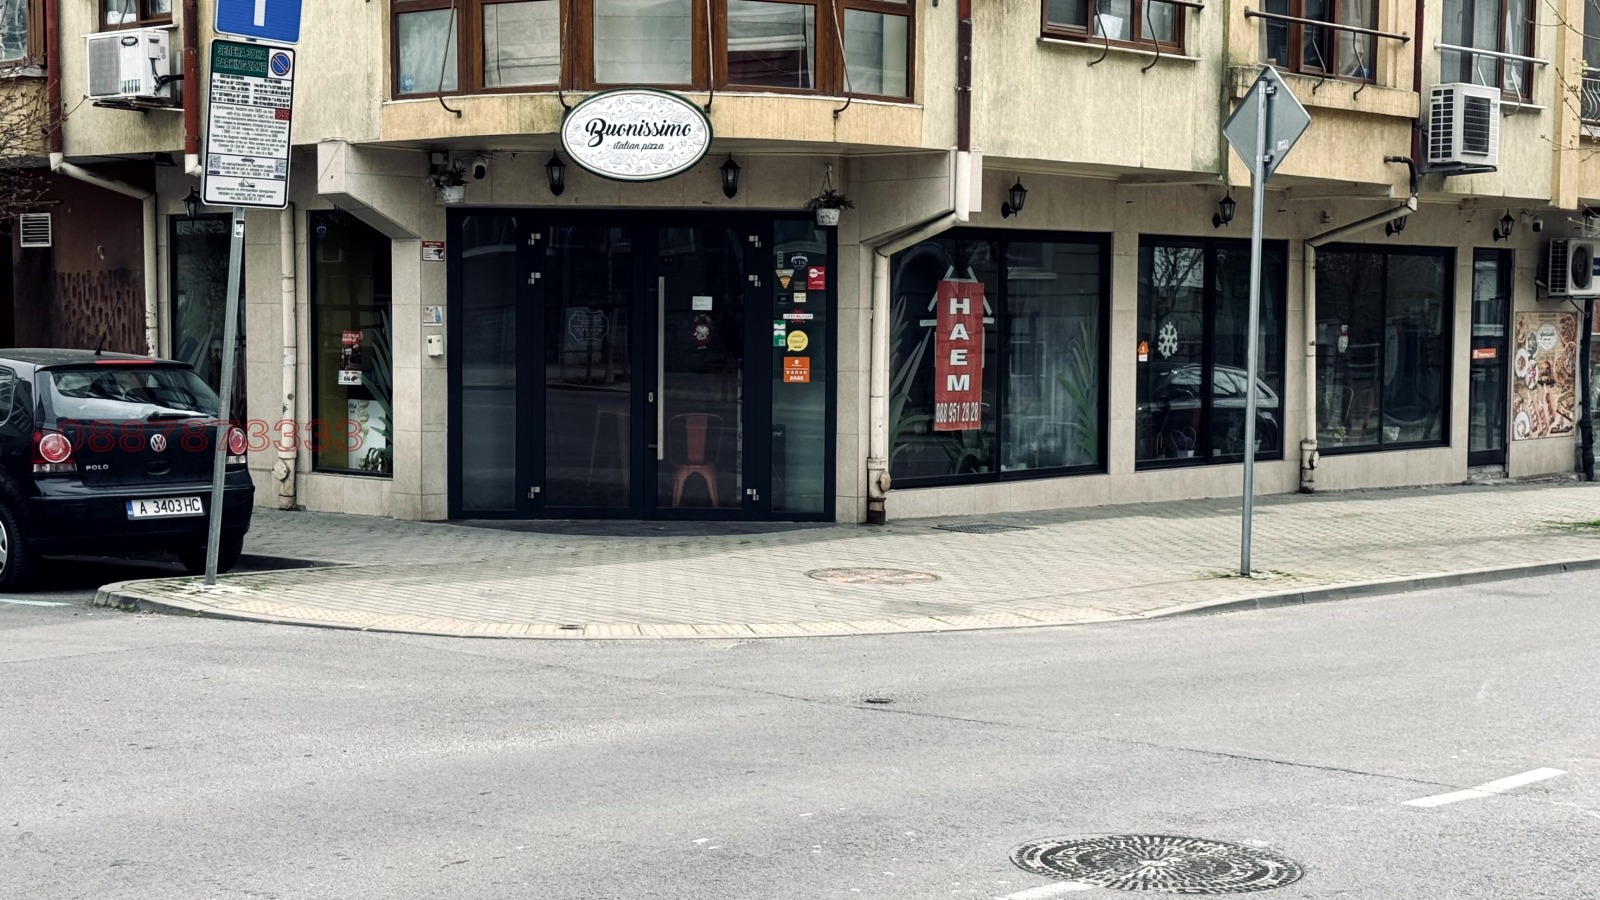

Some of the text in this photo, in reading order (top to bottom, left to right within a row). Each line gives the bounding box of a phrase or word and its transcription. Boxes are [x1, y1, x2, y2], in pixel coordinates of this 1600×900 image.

[217, 45, 266, 60] ЗЕЛЕНА ЗОНА
[215, 57, 267, 72] PARKING ZONE
[585, 118, 691, 147] Buonissimo
[613, 141, 664, 151] italian pizza
[947, 298, 971, 392] НАЕМ
[936, 401, 979, 423] 088 951 28 28
[140, 501, 148, 515] A
